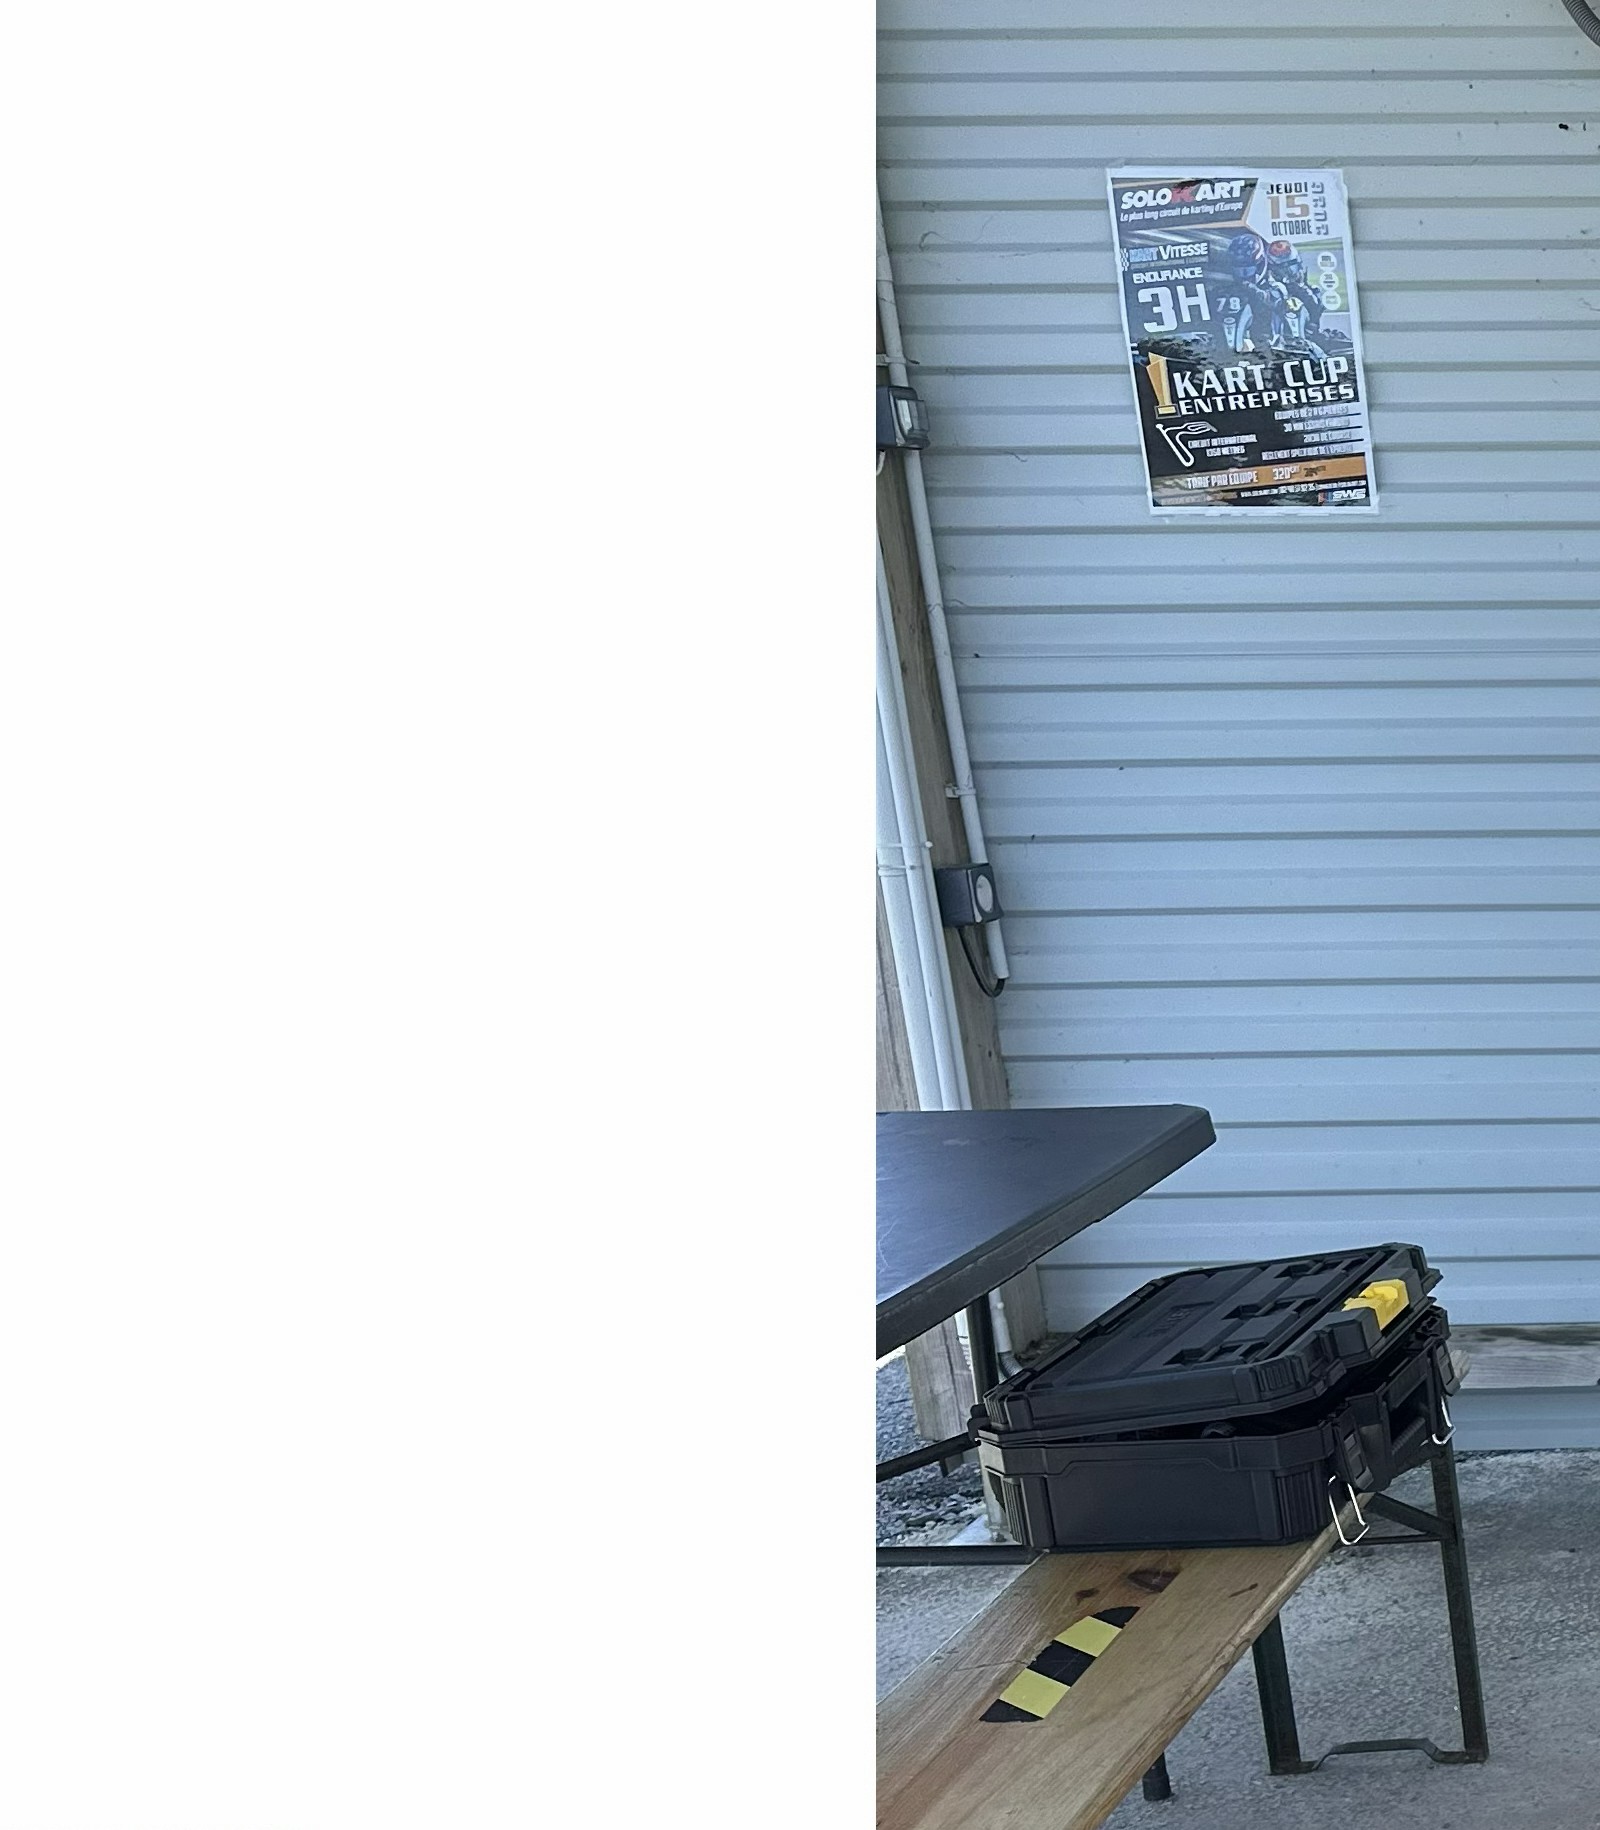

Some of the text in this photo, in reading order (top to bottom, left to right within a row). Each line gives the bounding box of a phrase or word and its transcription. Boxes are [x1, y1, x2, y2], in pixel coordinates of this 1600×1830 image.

[1121, 180, 1245, 209] SOLOKART
[1266, 182, 1308, 195] JEUDI
[1267, 194, 1309, 219] 15
[1271, 220, 1312, 236] OCTOBRE
[1132, 267, 1203, 284] ENDURANCE
[1138, 283, 1211, 333] 3H
[1173, 356, 1348, 399] KART CUP
[1179, 383, 1354, 416] ENTREPRISES
